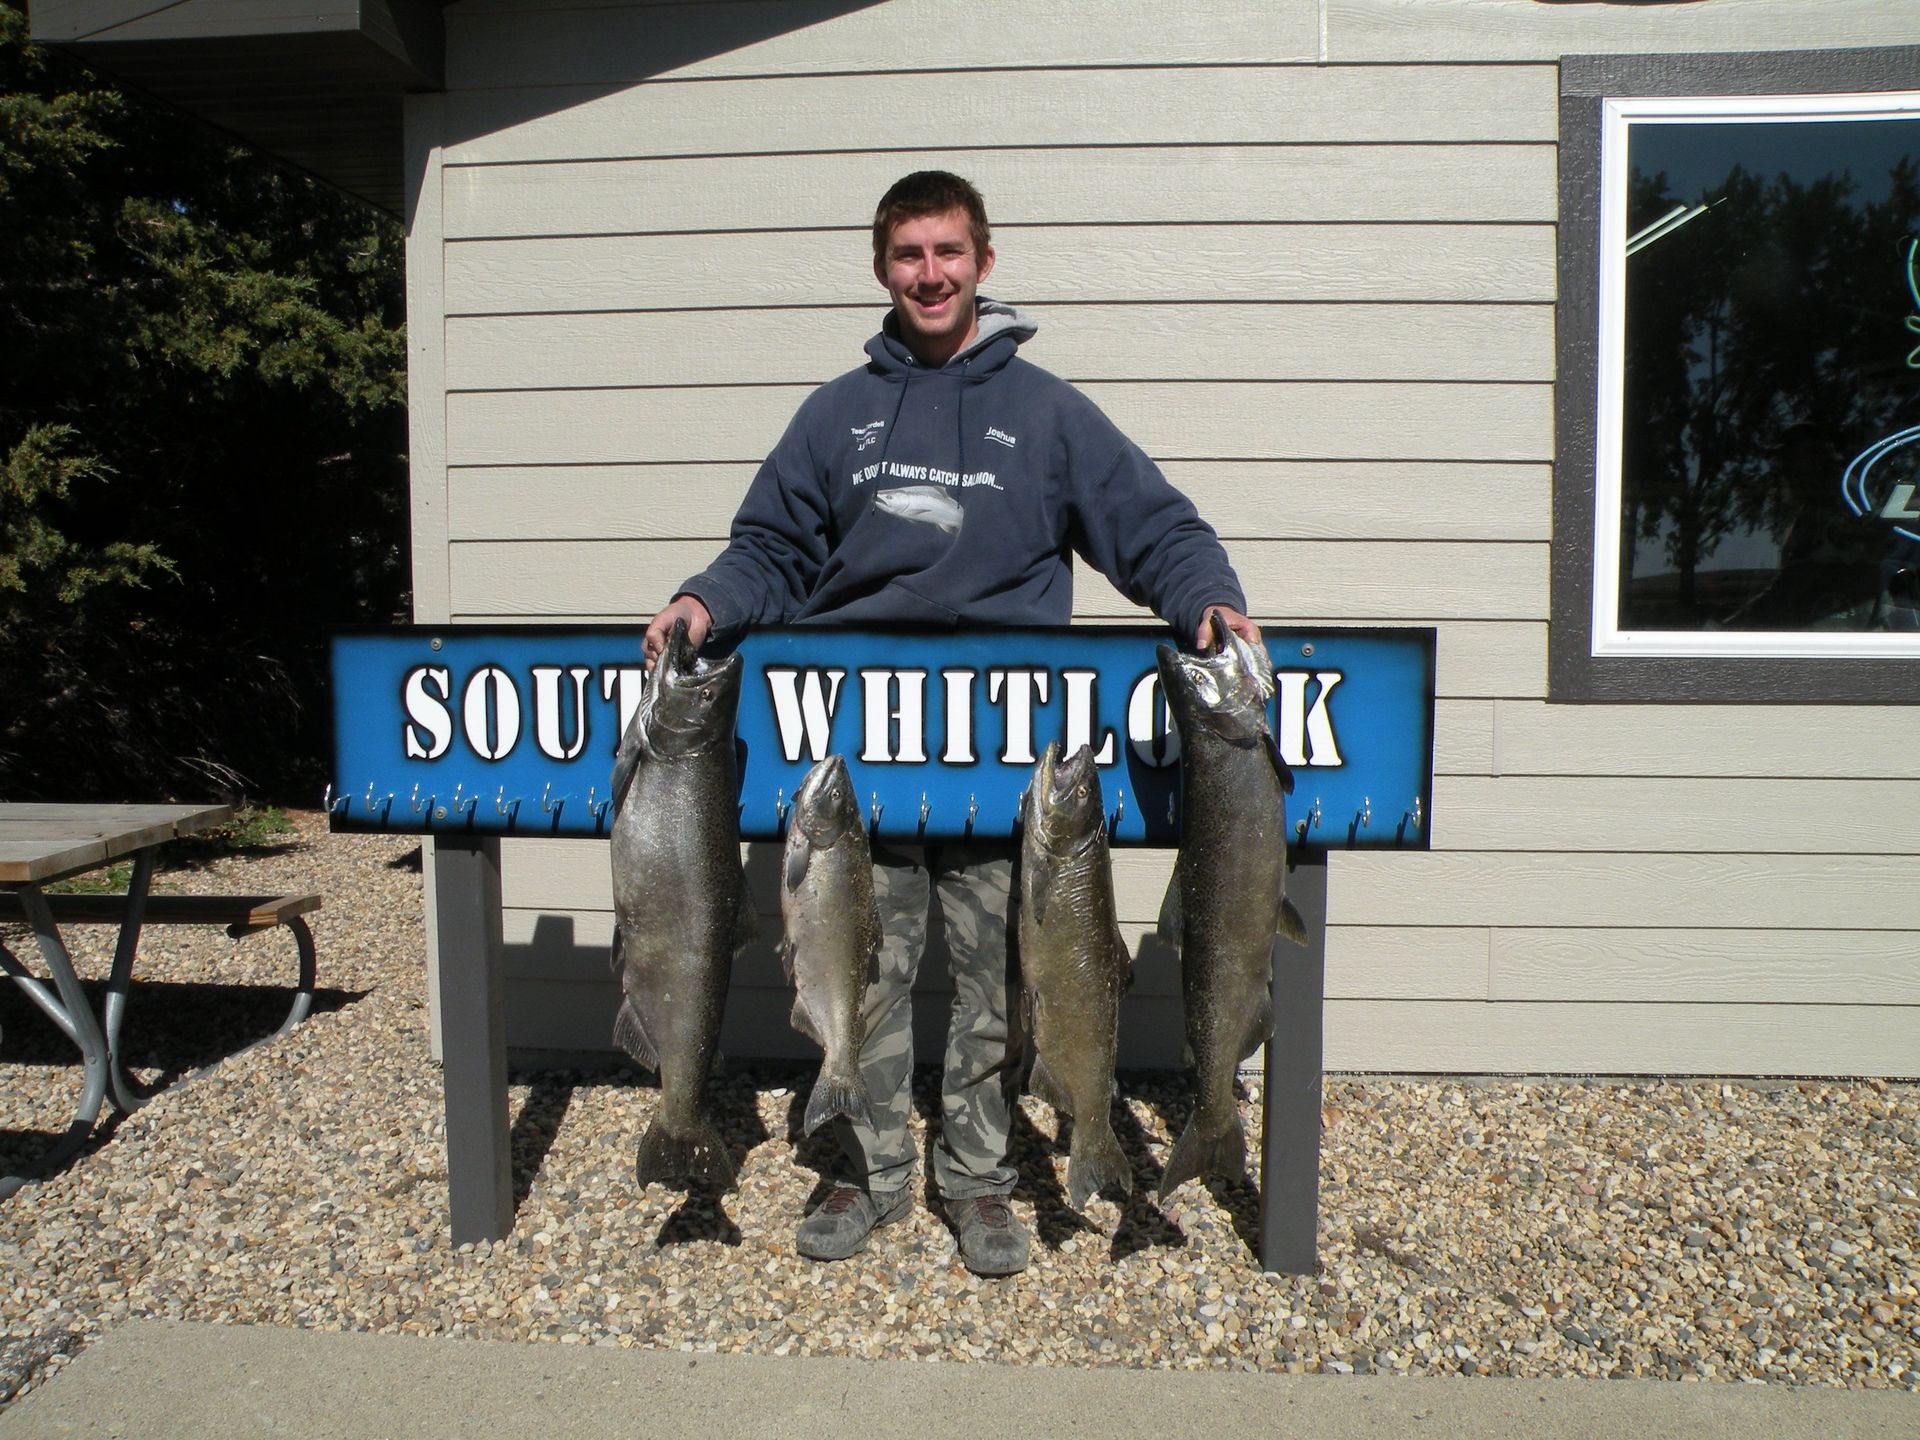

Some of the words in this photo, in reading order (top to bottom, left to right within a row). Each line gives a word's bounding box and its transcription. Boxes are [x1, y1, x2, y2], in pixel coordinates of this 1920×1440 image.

[985, 426, 1016, 444] Joshua
[852, 470, 864, 486] WE
[889, 462, 927, 480] ALWAYS
[928, 468, 960, 487] CATCH
[404, 667, 650, 761] SOUT
[766, 670, 1343, 767] WHITLOK
